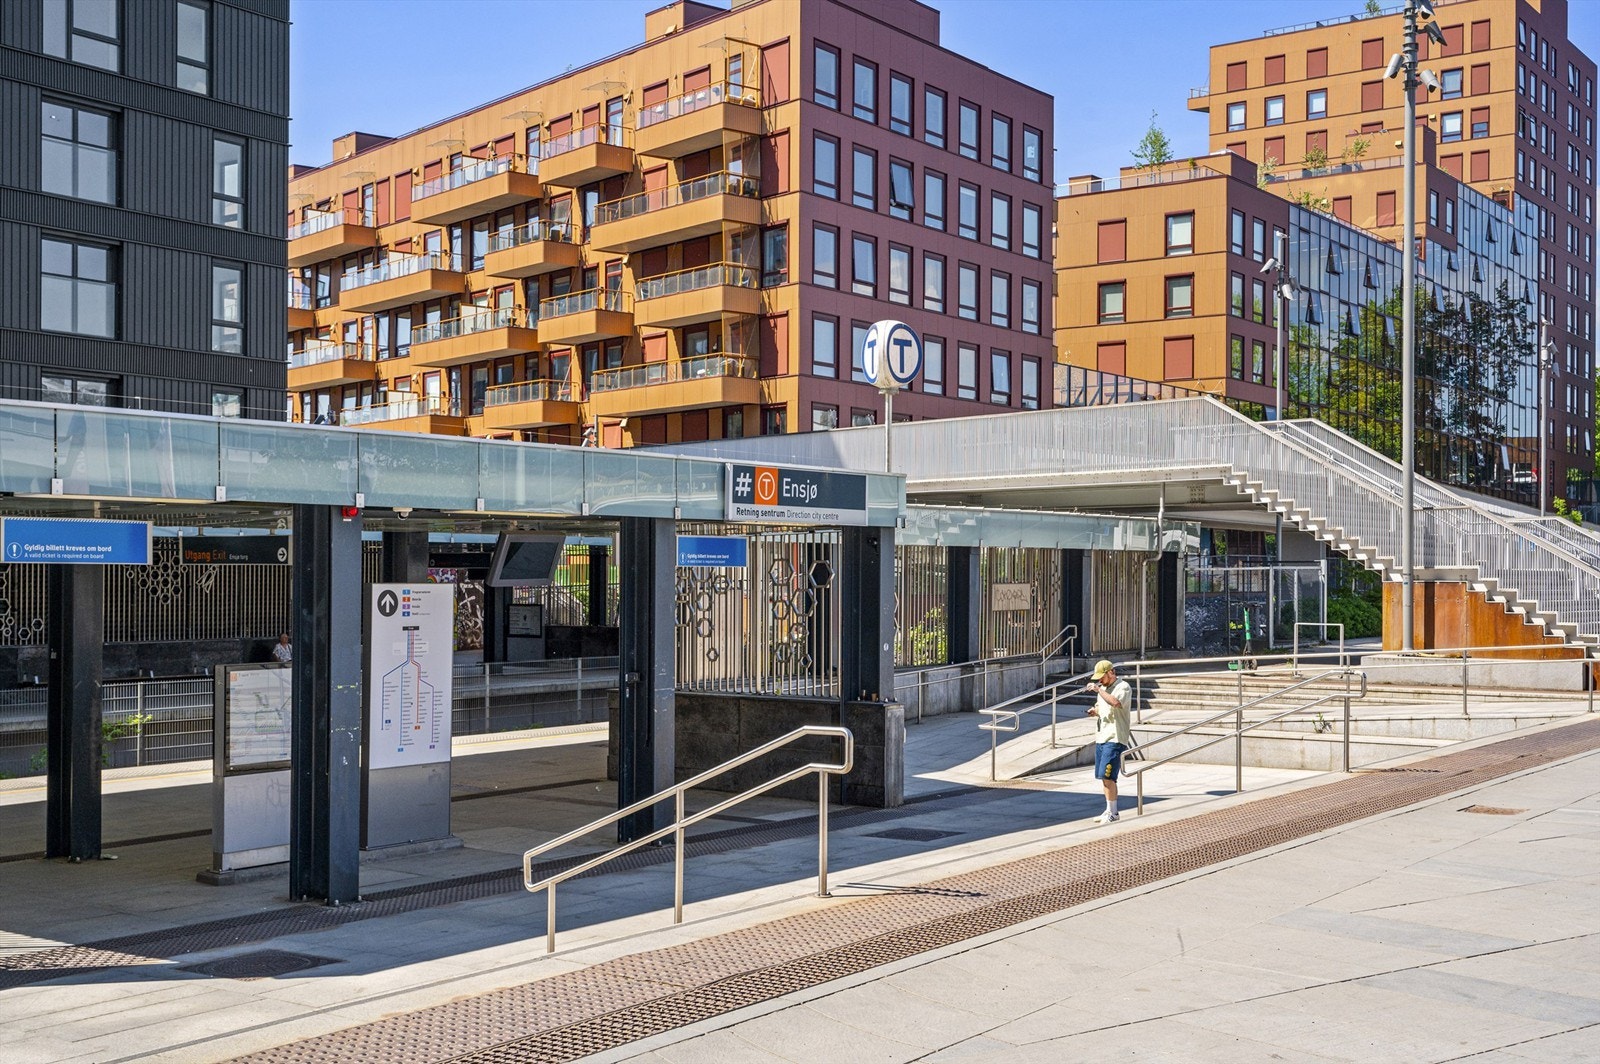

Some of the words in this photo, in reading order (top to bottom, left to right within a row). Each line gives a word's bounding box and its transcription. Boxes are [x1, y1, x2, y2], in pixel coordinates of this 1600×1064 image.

[868, 340, 877, 374] T
[893, 338, 912, 373] T
[783, 478, 818, 503] Ensjø
[736, 507, 759, 518] Retning
[760, 508, 786, 518] sentrum
[787, 509, 812, 519] Direction
[812, 510, 822, 521] city
[822, 512, 839, 520] centre
[24, 543, 45, 552] Gyldig
[46, 544, 65, 552] billett
[185, 550, 211, 562] Utgang
[212, 550, 227, 560] Exit
